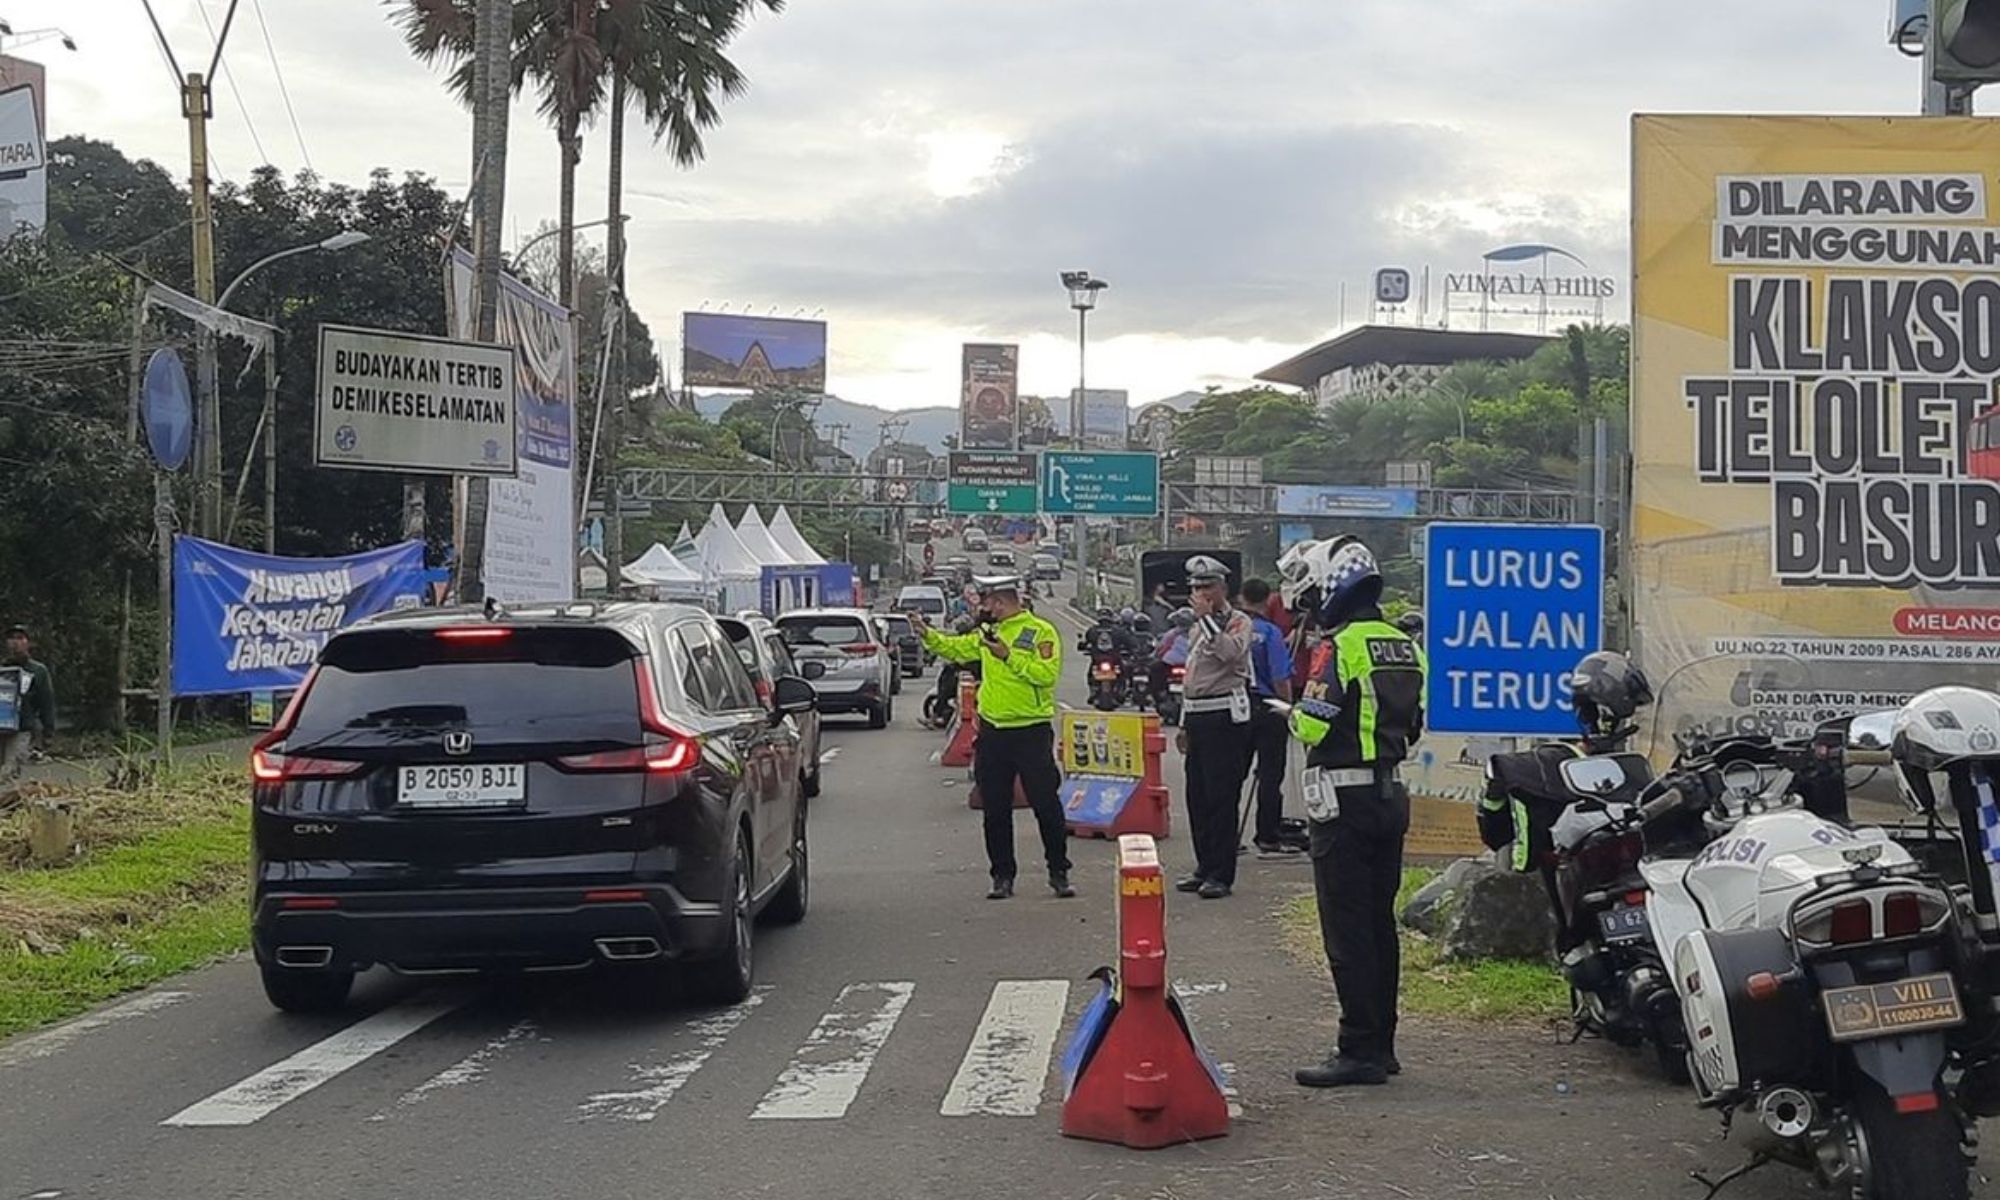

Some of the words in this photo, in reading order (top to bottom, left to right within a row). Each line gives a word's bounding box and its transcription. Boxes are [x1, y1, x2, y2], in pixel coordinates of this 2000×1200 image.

[1729, 179, 1975, 216] DILARANG
[1449, 273, 1548, 302] VIMALA
[1556, 276, 1615, 297] HILLS
[1733, 278, 2000, 374] KLAKSO
[335, 350, 441, 383] BUDAYAKAN
[446, 361, 503, 389] TERTIB
[332, 386, 505, 424] DEMIKESELAMATAN
[1686, 379, 1987, 475] TELOLET
[1775, 480, 2000, 578] BASUR
[1445, 549, 1583, 590] LURUS
[221, 603, 346, 641] Kecepatan
[1442, 609, 1586, 650] JALAN
[1907, 613, 2000, 631] MELANG
[226, 636, 319, 671] Jalanan
[1714, 641, 1738, 654] UU
[1768, 641, 1787, 655] 22
[1792, 643, 1845, 656] TAHUN
[1850, 643, 1885, 657] 2009
[1889, 645, 1941, 658] PASAL
[1945, 646, 1973, 658] 286
[1446, 670, 1574, 712] TERUS
[1753, 693, 1788, 705] DAN
[1860, 694, 1916, 707] MENG
[405, 769, 417, 790] B
[425, 768, 474, 789] 2059
[481, 767, 518, 788] BJI
[1893, 982, 1933, 1003] VIII
